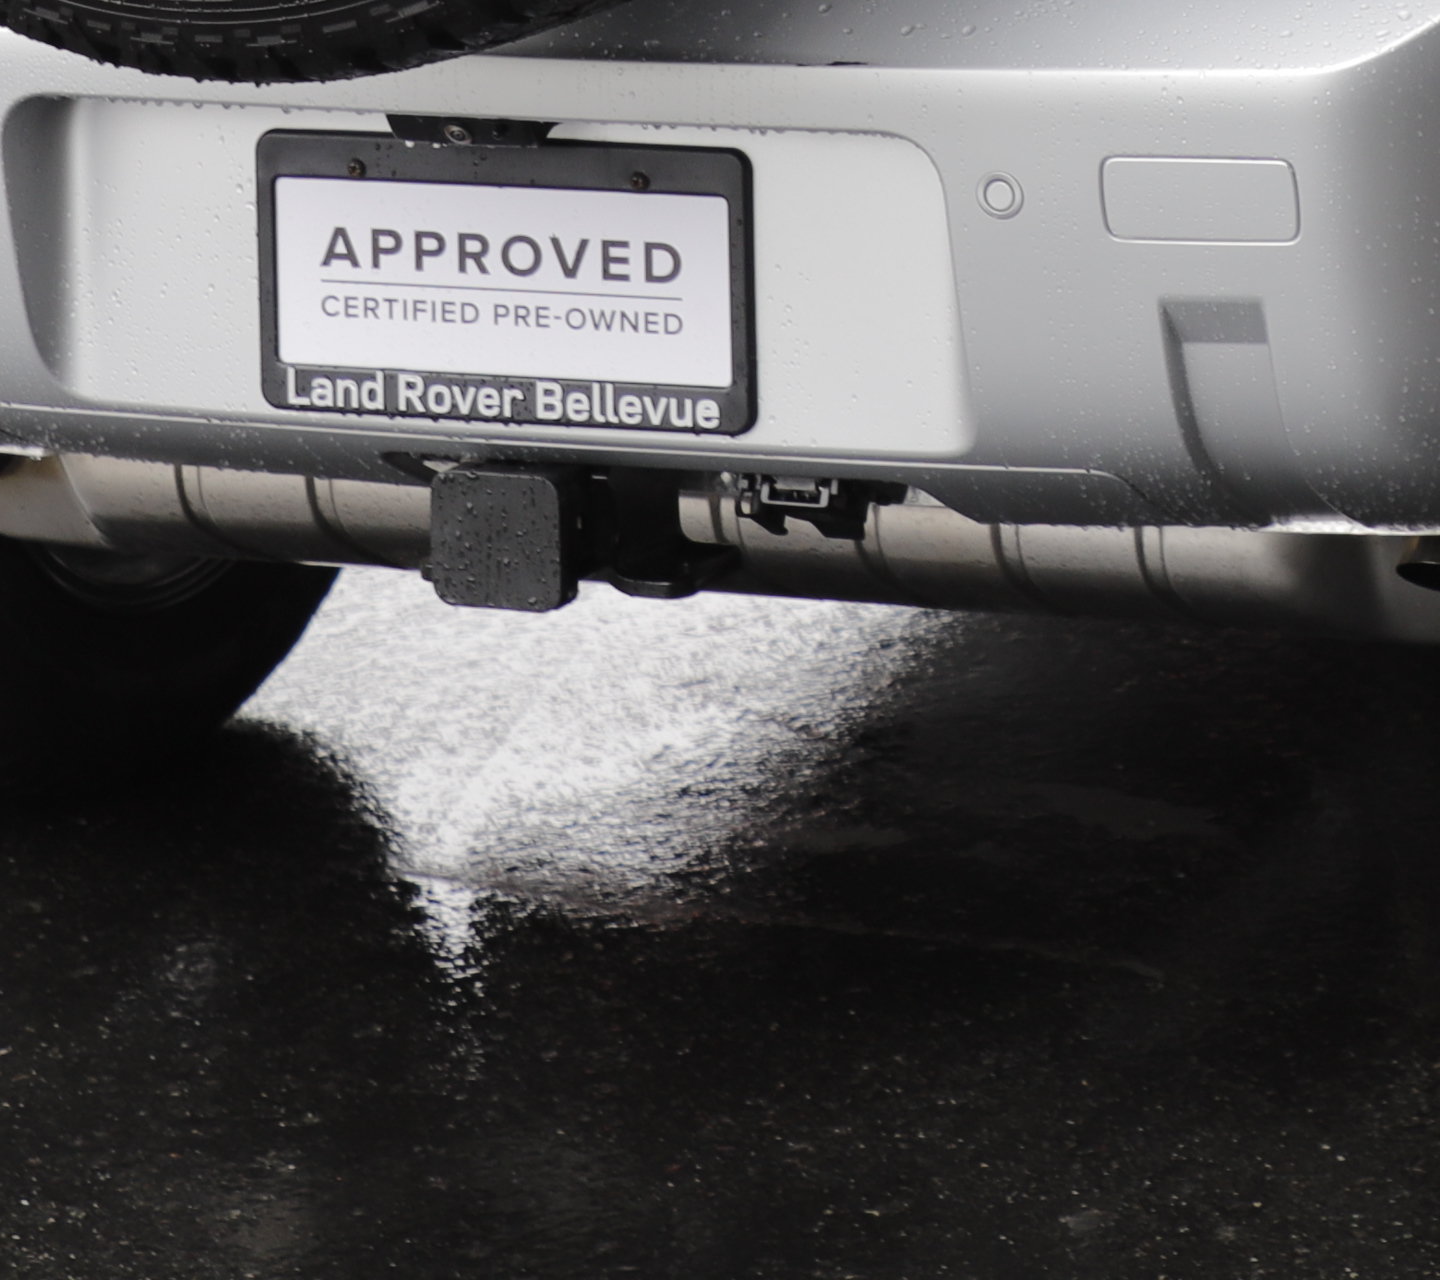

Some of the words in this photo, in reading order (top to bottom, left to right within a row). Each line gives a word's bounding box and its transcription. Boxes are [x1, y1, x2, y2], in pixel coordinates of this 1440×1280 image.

[320, 226, 683, 285] APPROVED
[320, 293, 480, 325] CERTIFIED
[493, 302, 685, 336] PRE-OWNED
[286, 366, 386, 413] Land
[396, 371, 525, 420] Rover
[534, 380, 722, 431] Bellevue
